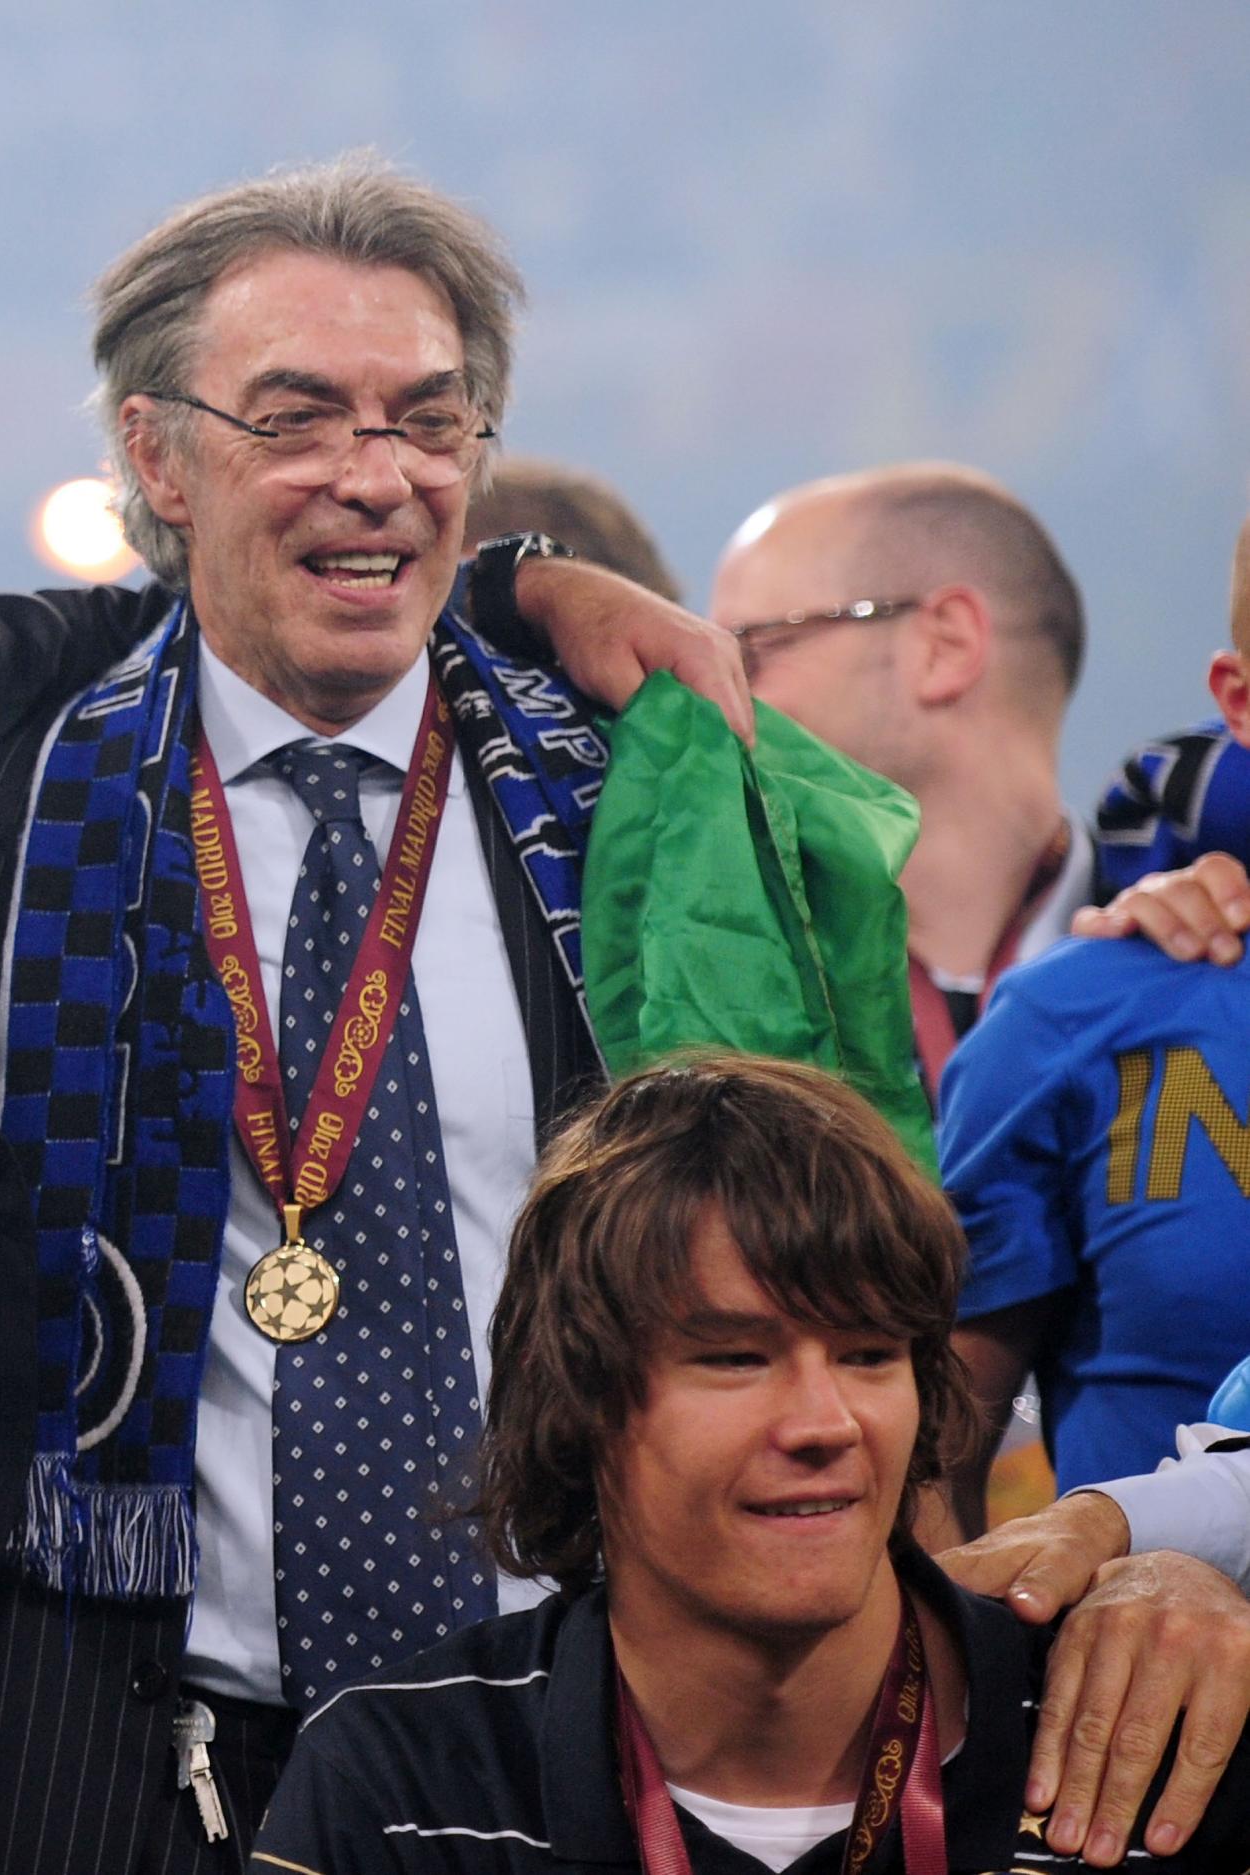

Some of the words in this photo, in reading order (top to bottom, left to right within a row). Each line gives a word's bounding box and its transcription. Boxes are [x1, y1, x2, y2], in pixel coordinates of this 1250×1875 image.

[191, 788, 229, 891] MADRID
[379, 872, 416, 949] FINAL
[400, 777, 438, 873] MADRID
[422, 730, 447, 778] 2010
[208, 892, 238, 940] 2010
[308, 1112, 344, 1160] 2010
